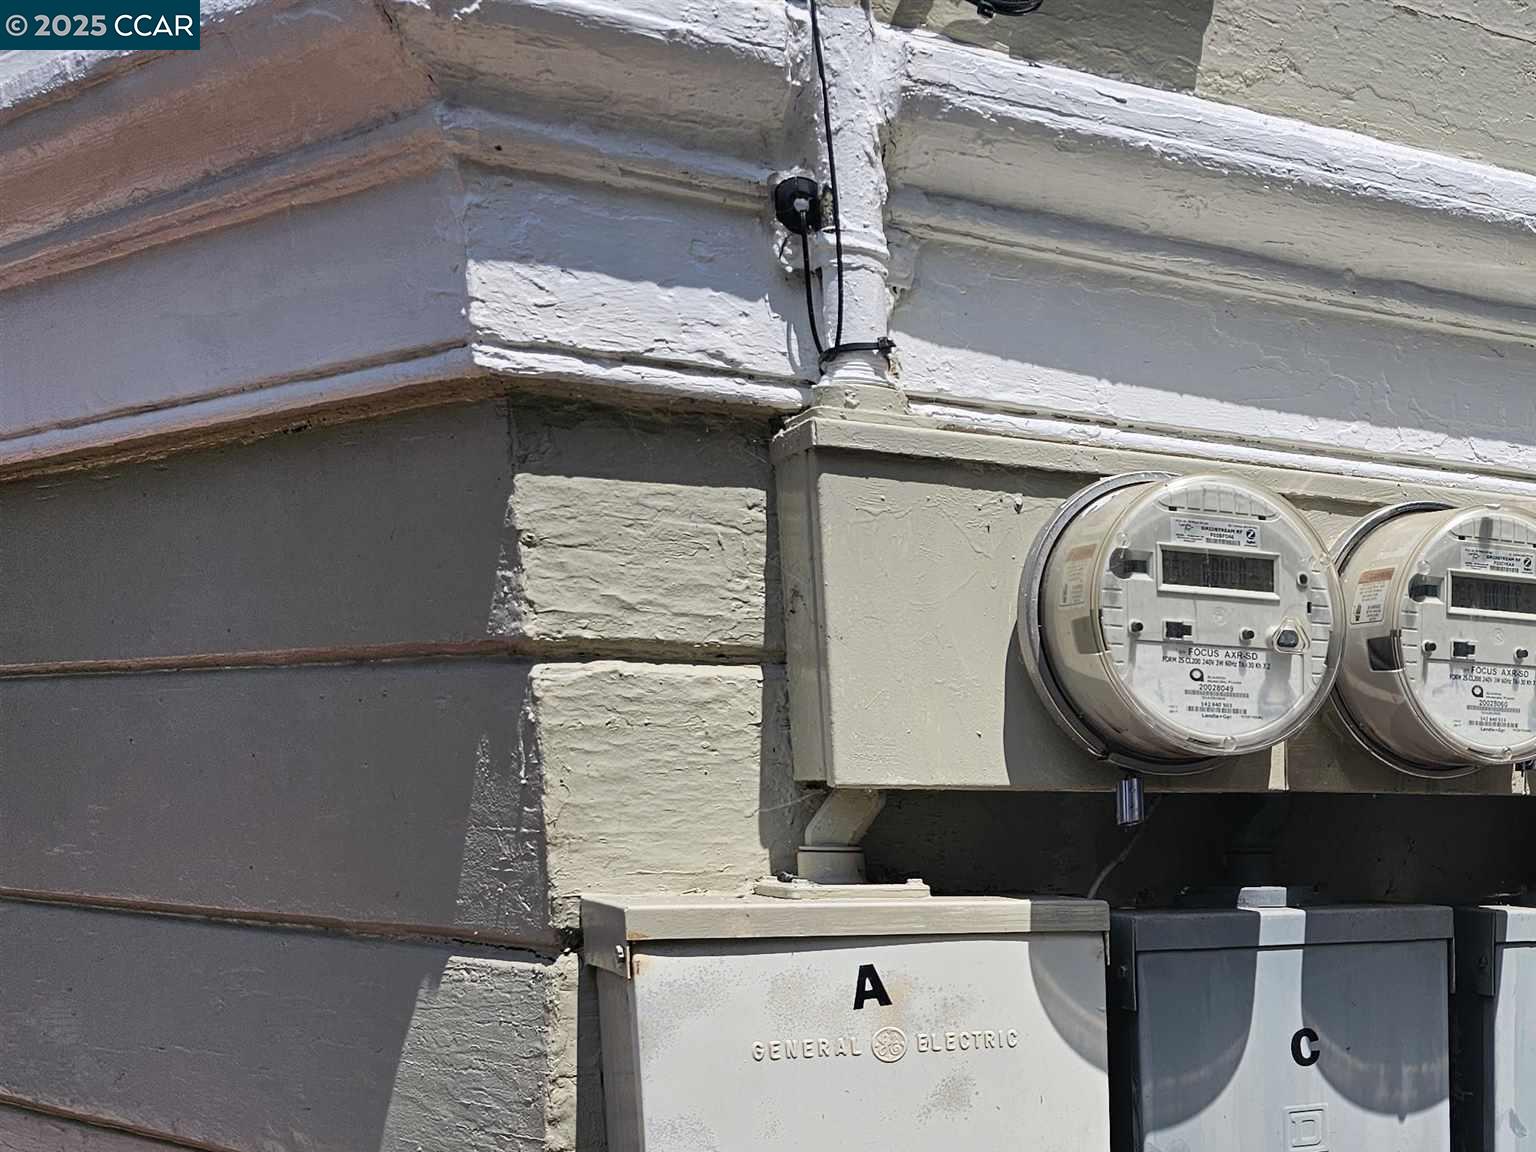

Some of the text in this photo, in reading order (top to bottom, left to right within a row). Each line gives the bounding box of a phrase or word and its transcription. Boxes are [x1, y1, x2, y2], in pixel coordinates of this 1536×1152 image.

[1188, 648, 1258, 661] FOCUS AXR-SD
[1471, 666, 1498, 675] FOCUS
[853, 963, 893, 1010] A
[752, 1036, 862, 1062] GENERAL
[916, 1029, 1018, 1053] ELECTRIC
[1291, 1027, 1320, 1066] C
